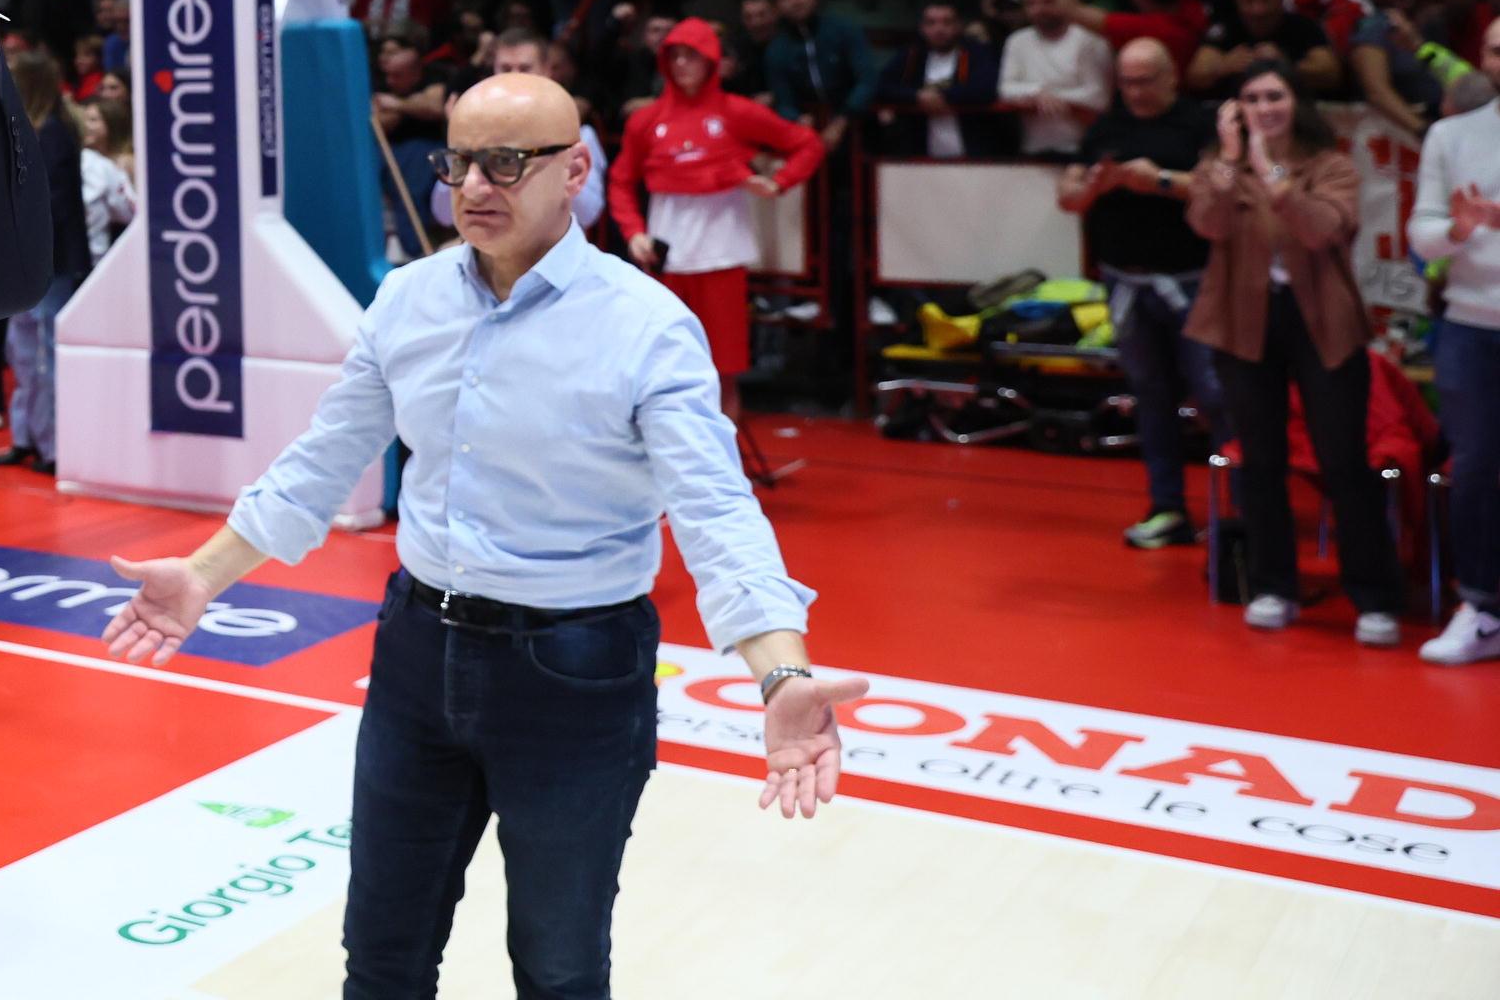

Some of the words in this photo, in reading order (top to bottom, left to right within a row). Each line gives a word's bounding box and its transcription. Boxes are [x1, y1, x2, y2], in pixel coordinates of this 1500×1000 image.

[117, 853, 317, 945] Giorgio
[285, 816, 353, 850] Te
[1249, 815, 1452, 862] cose
